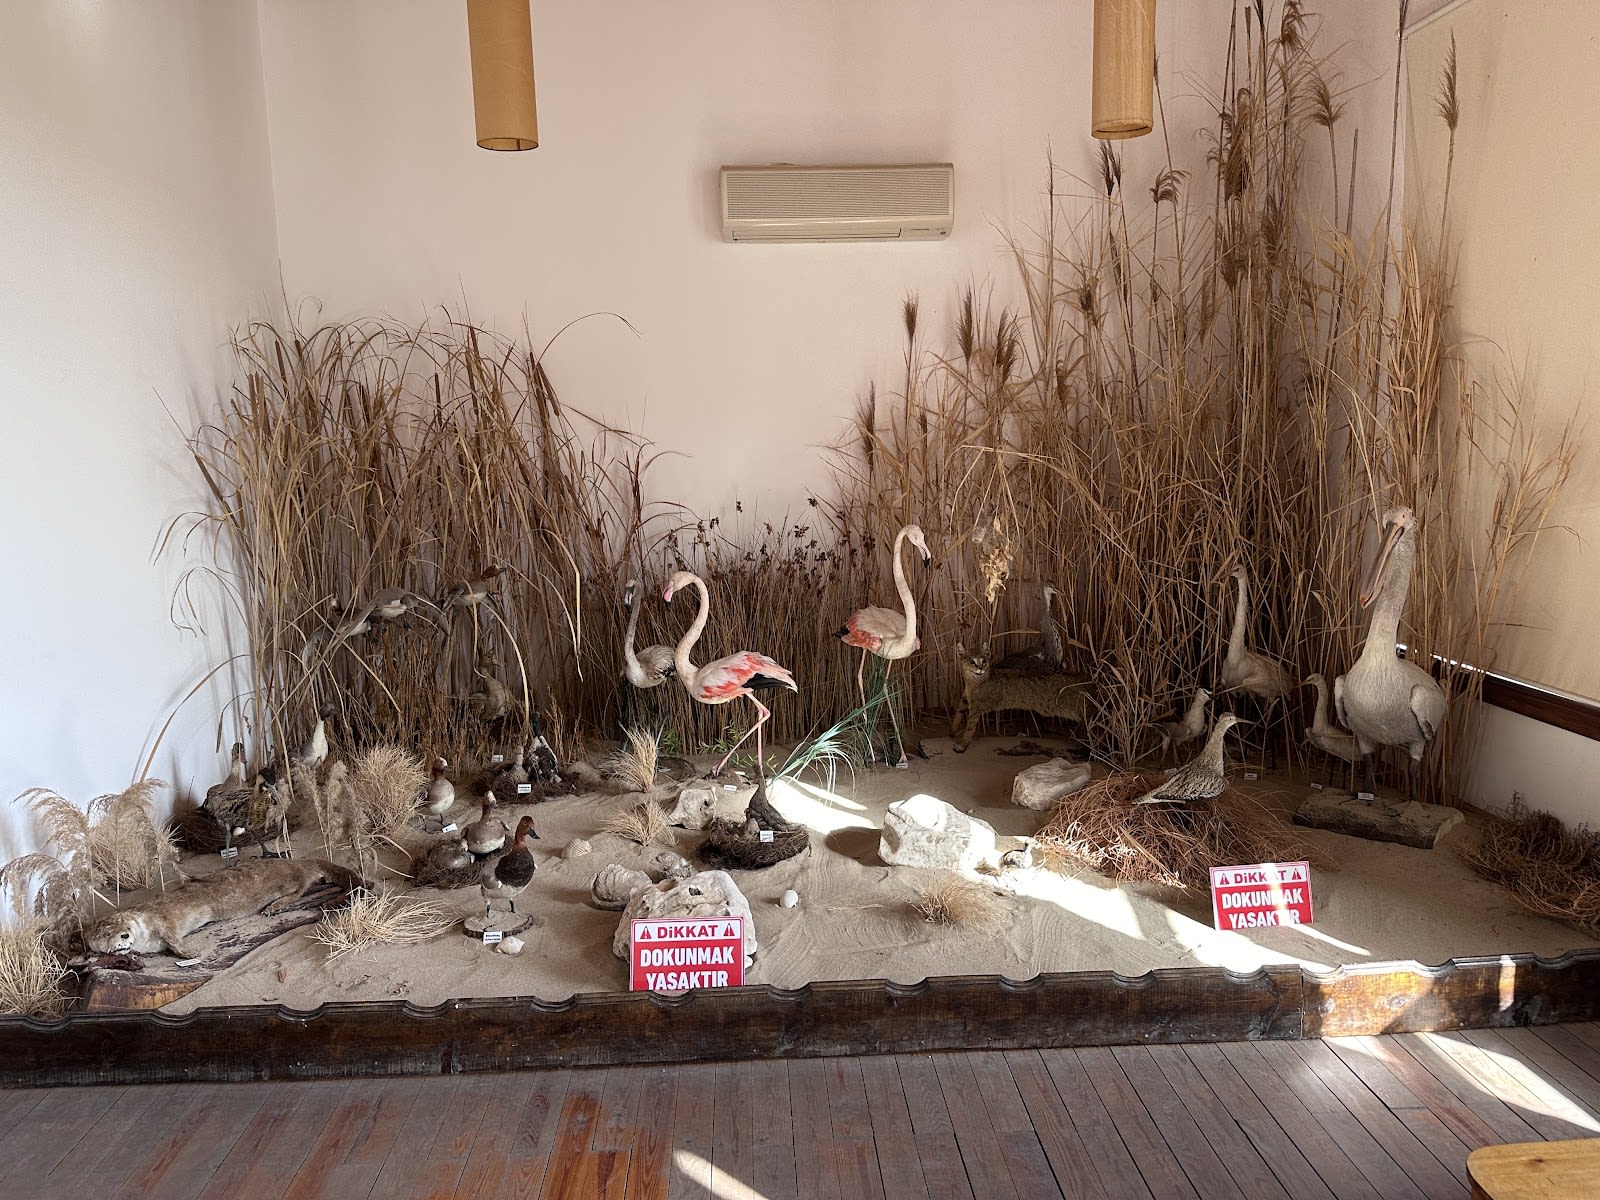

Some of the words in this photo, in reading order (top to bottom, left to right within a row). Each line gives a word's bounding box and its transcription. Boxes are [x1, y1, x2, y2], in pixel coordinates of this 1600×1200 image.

[1228, 909, 1300, 929] YASAKTR
[640, 945, 735, 968] DOKUNMAK
[646, 970, 729, 991] YASAKTIR
